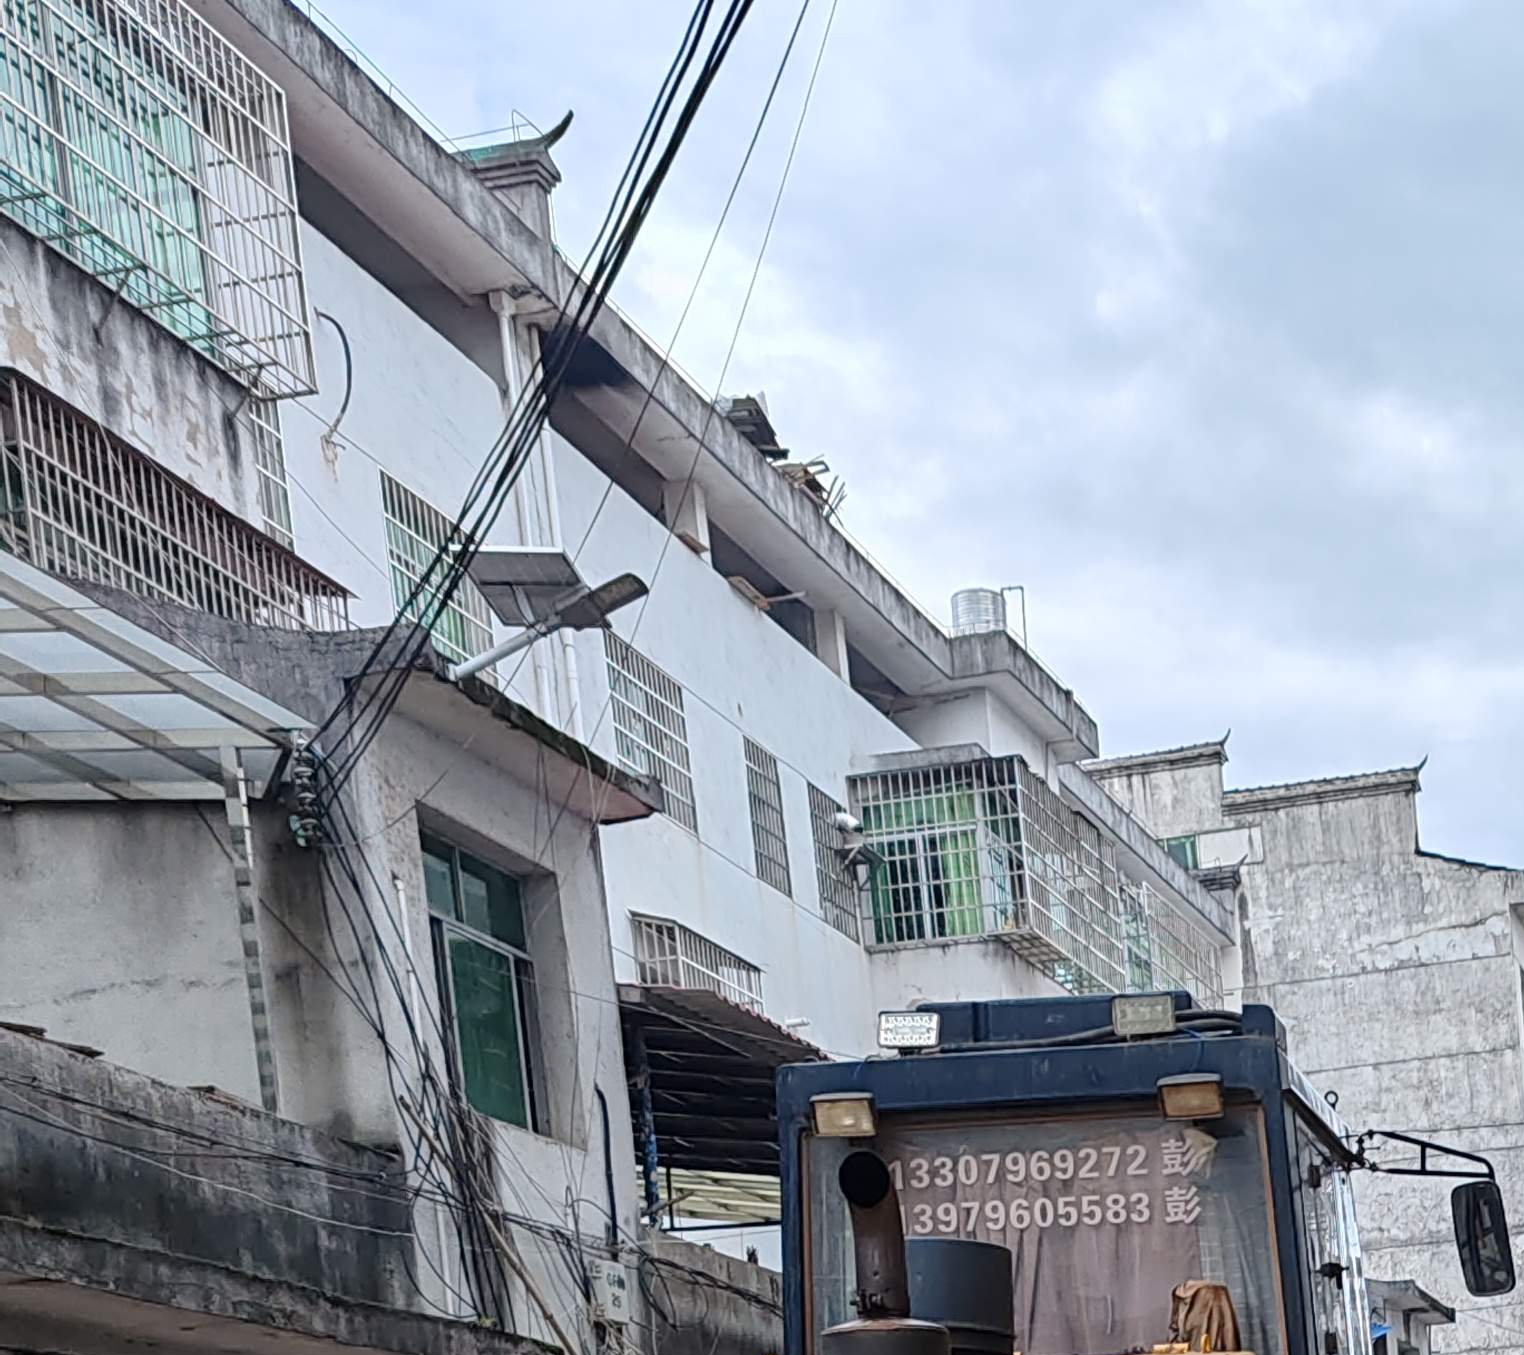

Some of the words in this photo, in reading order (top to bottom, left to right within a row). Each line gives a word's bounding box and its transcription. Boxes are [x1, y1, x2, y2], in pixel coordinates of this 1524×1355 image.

[888, 1144, 1148, 1190] 13307969272
[1161, 1138, 1200, 1178] 彭
[1165, 1186, 1203, 1225] 彭
